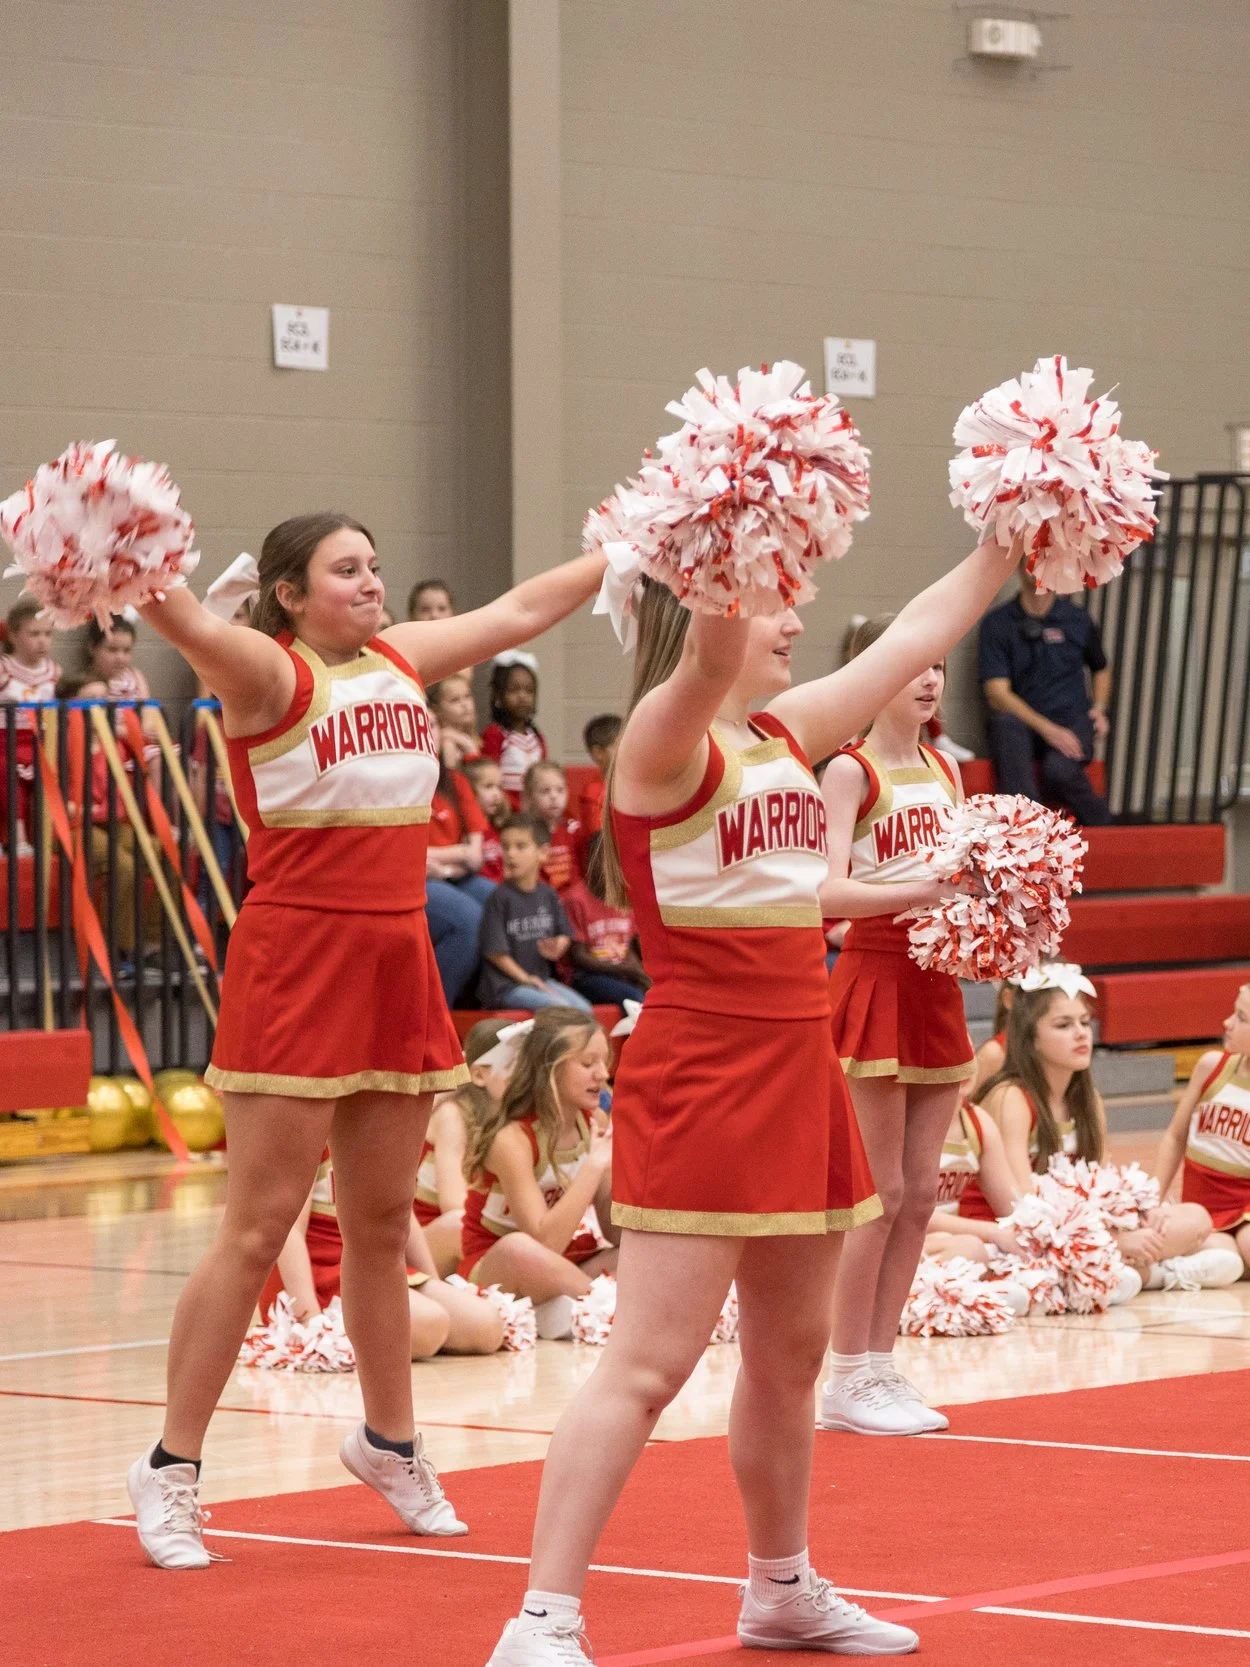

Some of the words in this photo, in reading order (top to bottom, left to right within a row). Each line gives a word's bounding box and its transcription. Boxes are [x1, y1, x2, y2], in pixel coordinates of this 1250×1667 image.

[310, 700, 439, 775] WARRIOR
[717, 789, 829, 869] WARRIOR
[873, 805, 950, 864] WARRI
